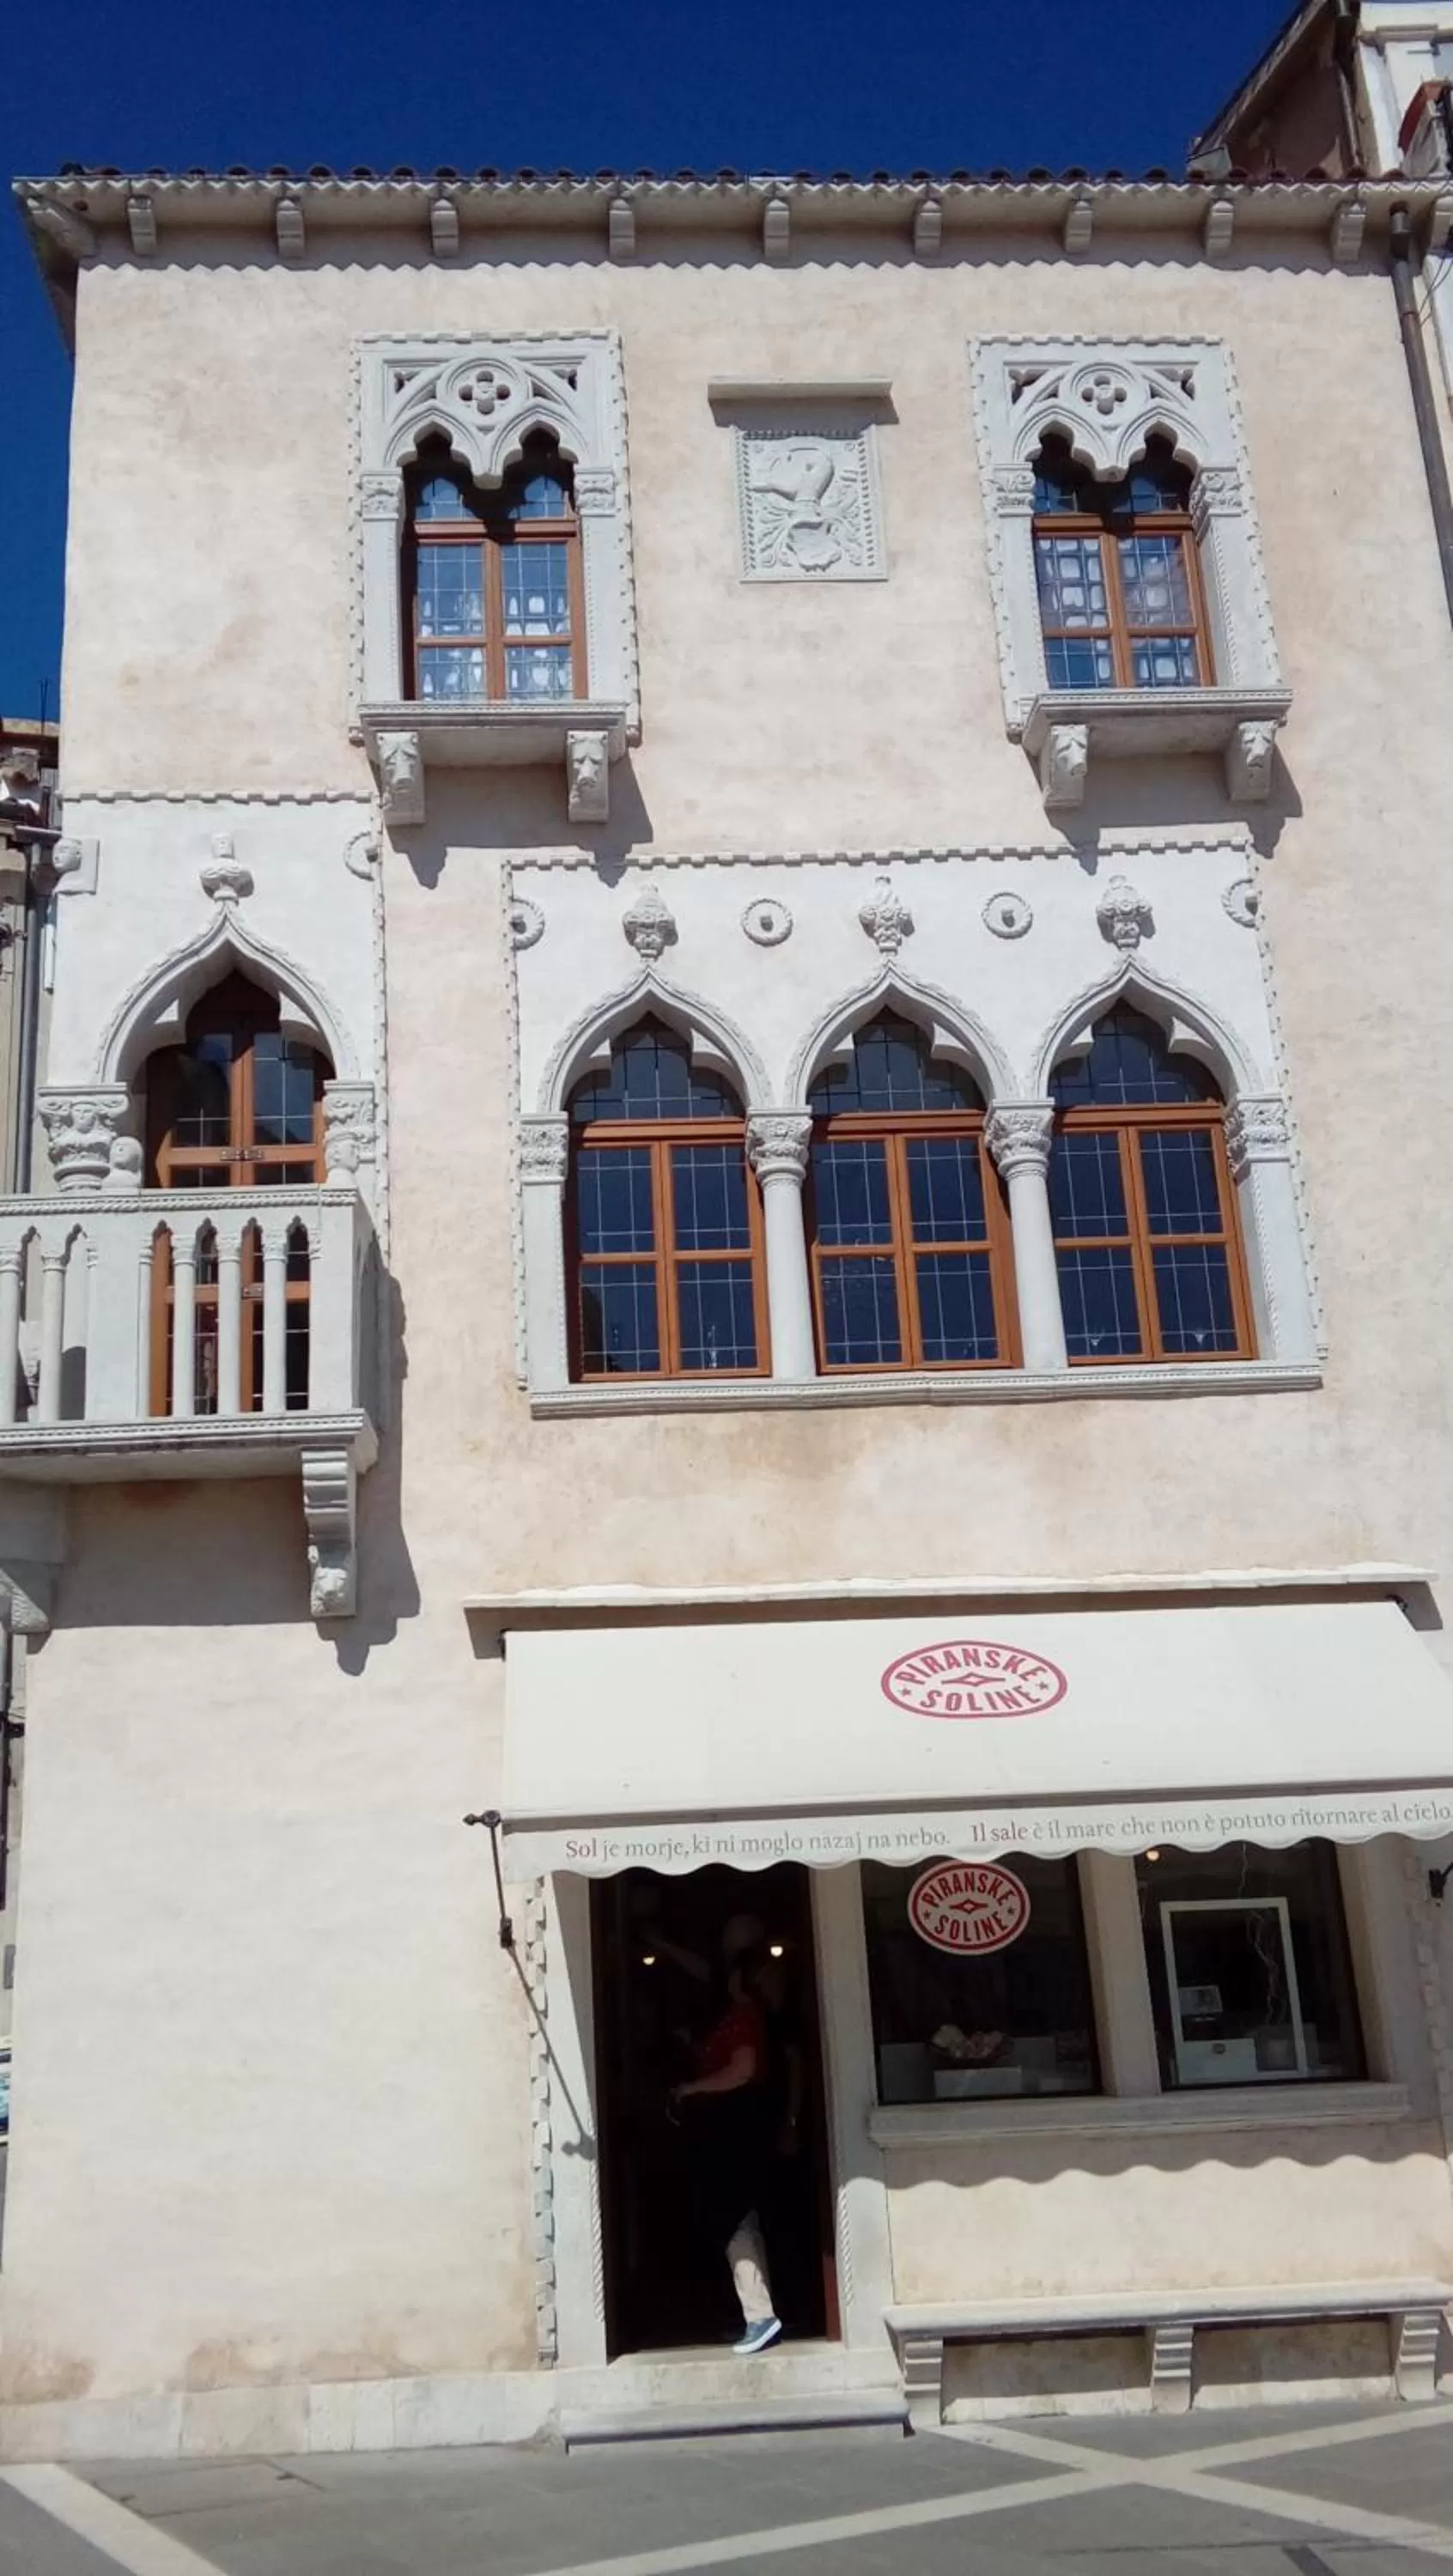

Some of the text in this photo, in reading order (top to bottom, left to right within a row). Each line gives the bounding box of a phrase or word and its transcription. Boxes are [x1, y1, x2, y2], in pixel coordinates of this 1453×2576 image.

[895, 1647, 1048, 1685] PIRANSKE
[920, 1685, 1042, 1711] SOLINE
[971, 1821, 987, 1842] Il
[990, 1820, 1028, 1842] sale
[1033, 1822, 1043, 1839] è
[1049, 1819, 1061, 1839] il
[1066, 1821, 1116, 1838] mare
[1121, 1814, 1155, 1836] che
[1161, 1817, 1201, 1834] non
[1205, 1813, 1216, 1832] è
[1220, 1812, 1286, 1836] potuto
[1292, 1807, 1377, 1827] ritornare
[1383, 1802, 1400, 1823] al
[565, 1826, 951, 1862] Sol je morje, ki ni moglo nazaj na nebo.
[921, 1871, 1016, 1908] PIRANSKE
[934, 1911, 1007, 1942] SOLINE
